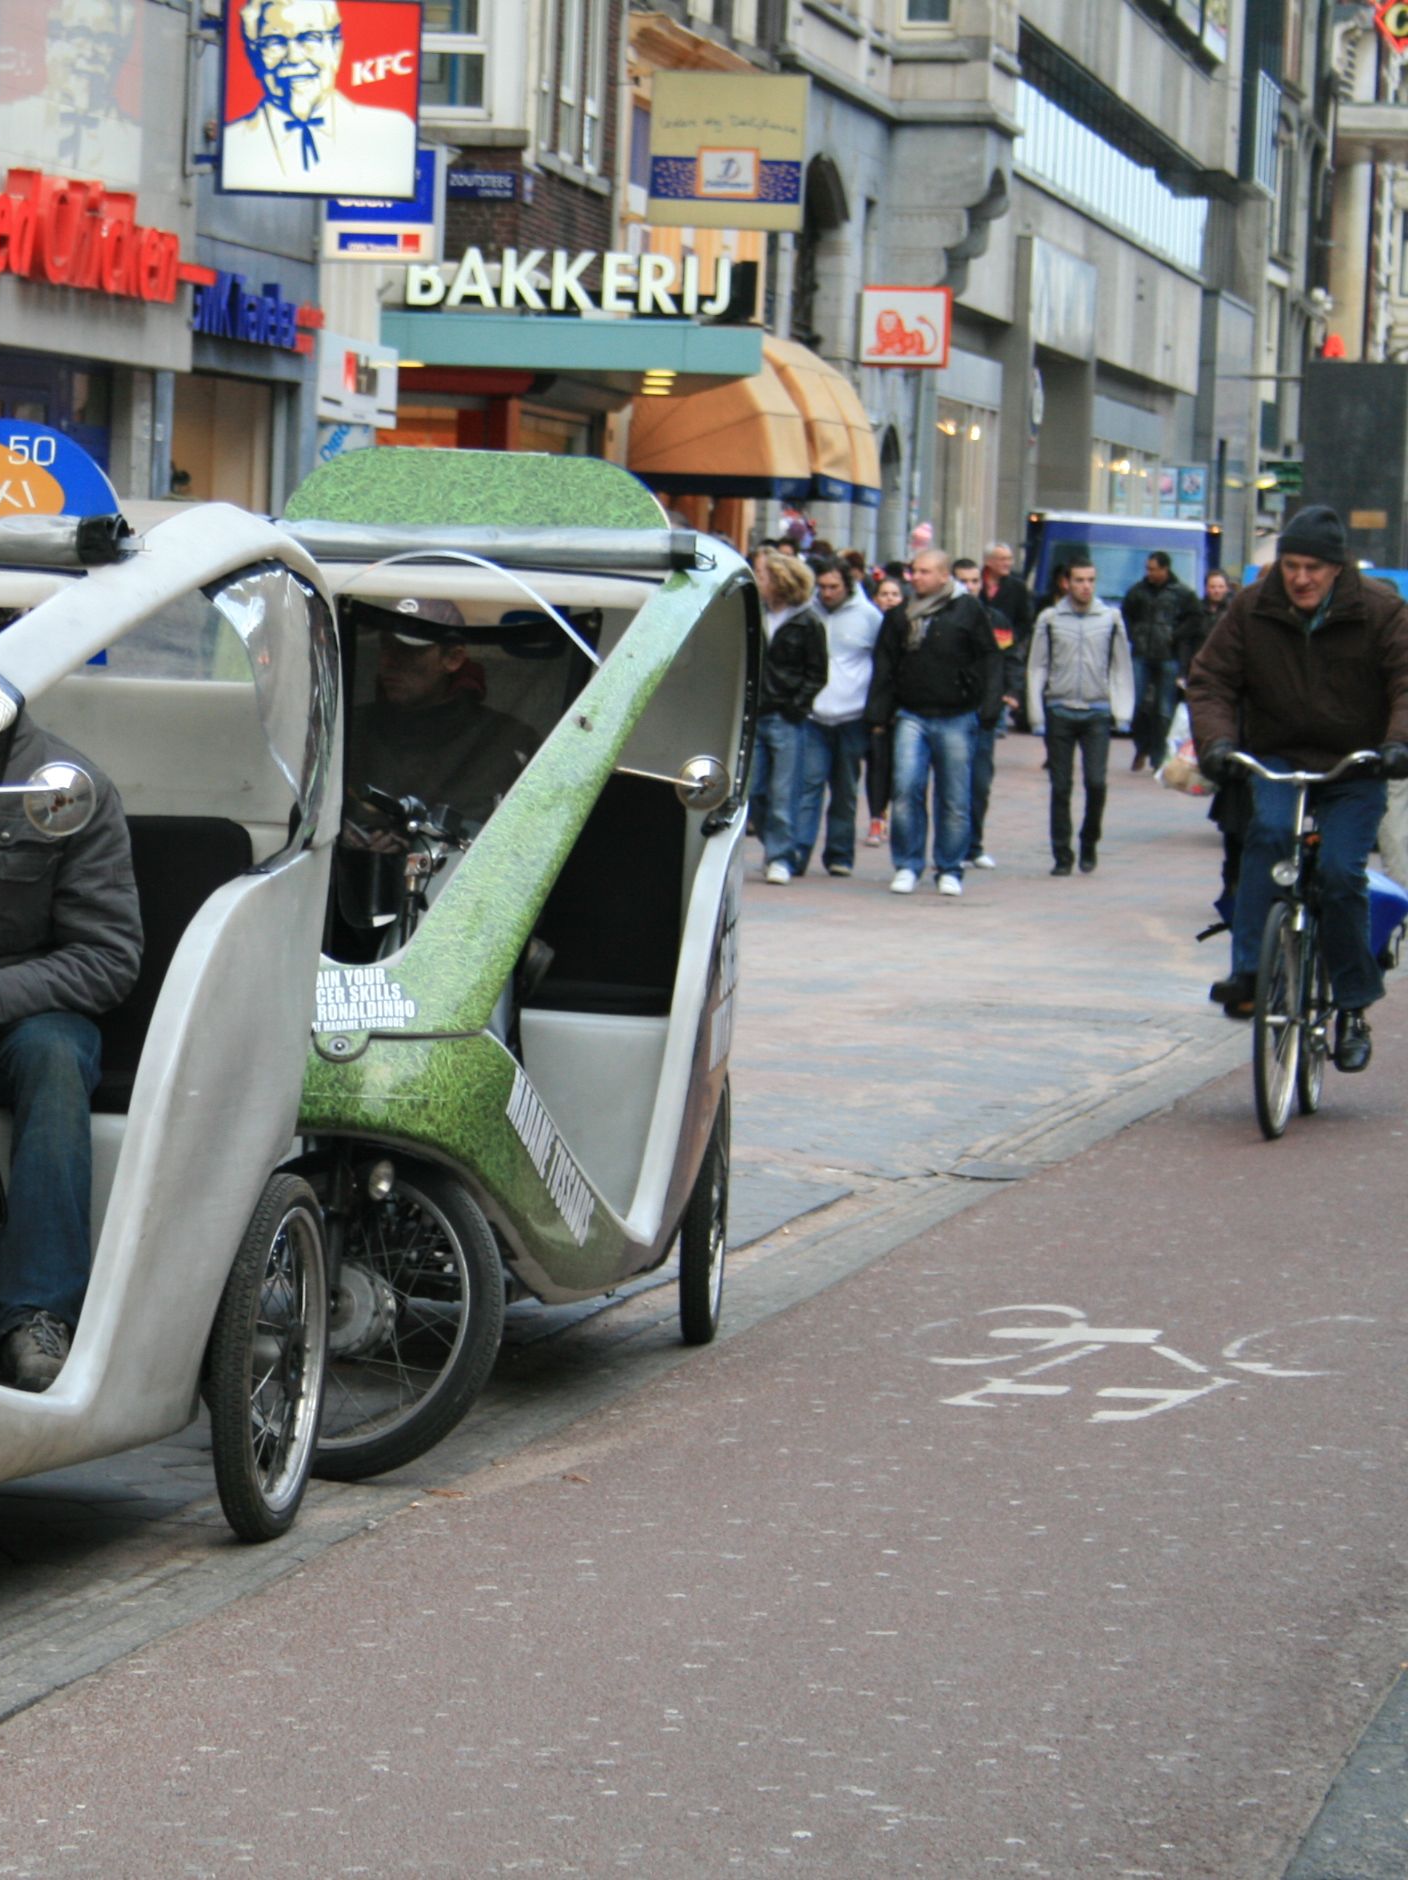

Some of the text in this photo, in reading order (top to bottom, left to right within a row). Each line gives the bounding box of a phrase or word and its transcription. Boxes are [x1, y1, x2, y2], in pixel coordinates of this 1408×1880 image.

[351, 50, 414, 87] KFC
[406, 247, 732, 316] BAKKERIJ
[7, 436, 56, 466] 50
[344, 968, 385, 986] YOUR
[349, 983, 401, 1002] SKILLS
[317, 1000, 415, 1021] RONALDINHO
[323, 1019, 359, 1031] MADAME
[361, 1017, 405, 1029] TUSSAUDS
